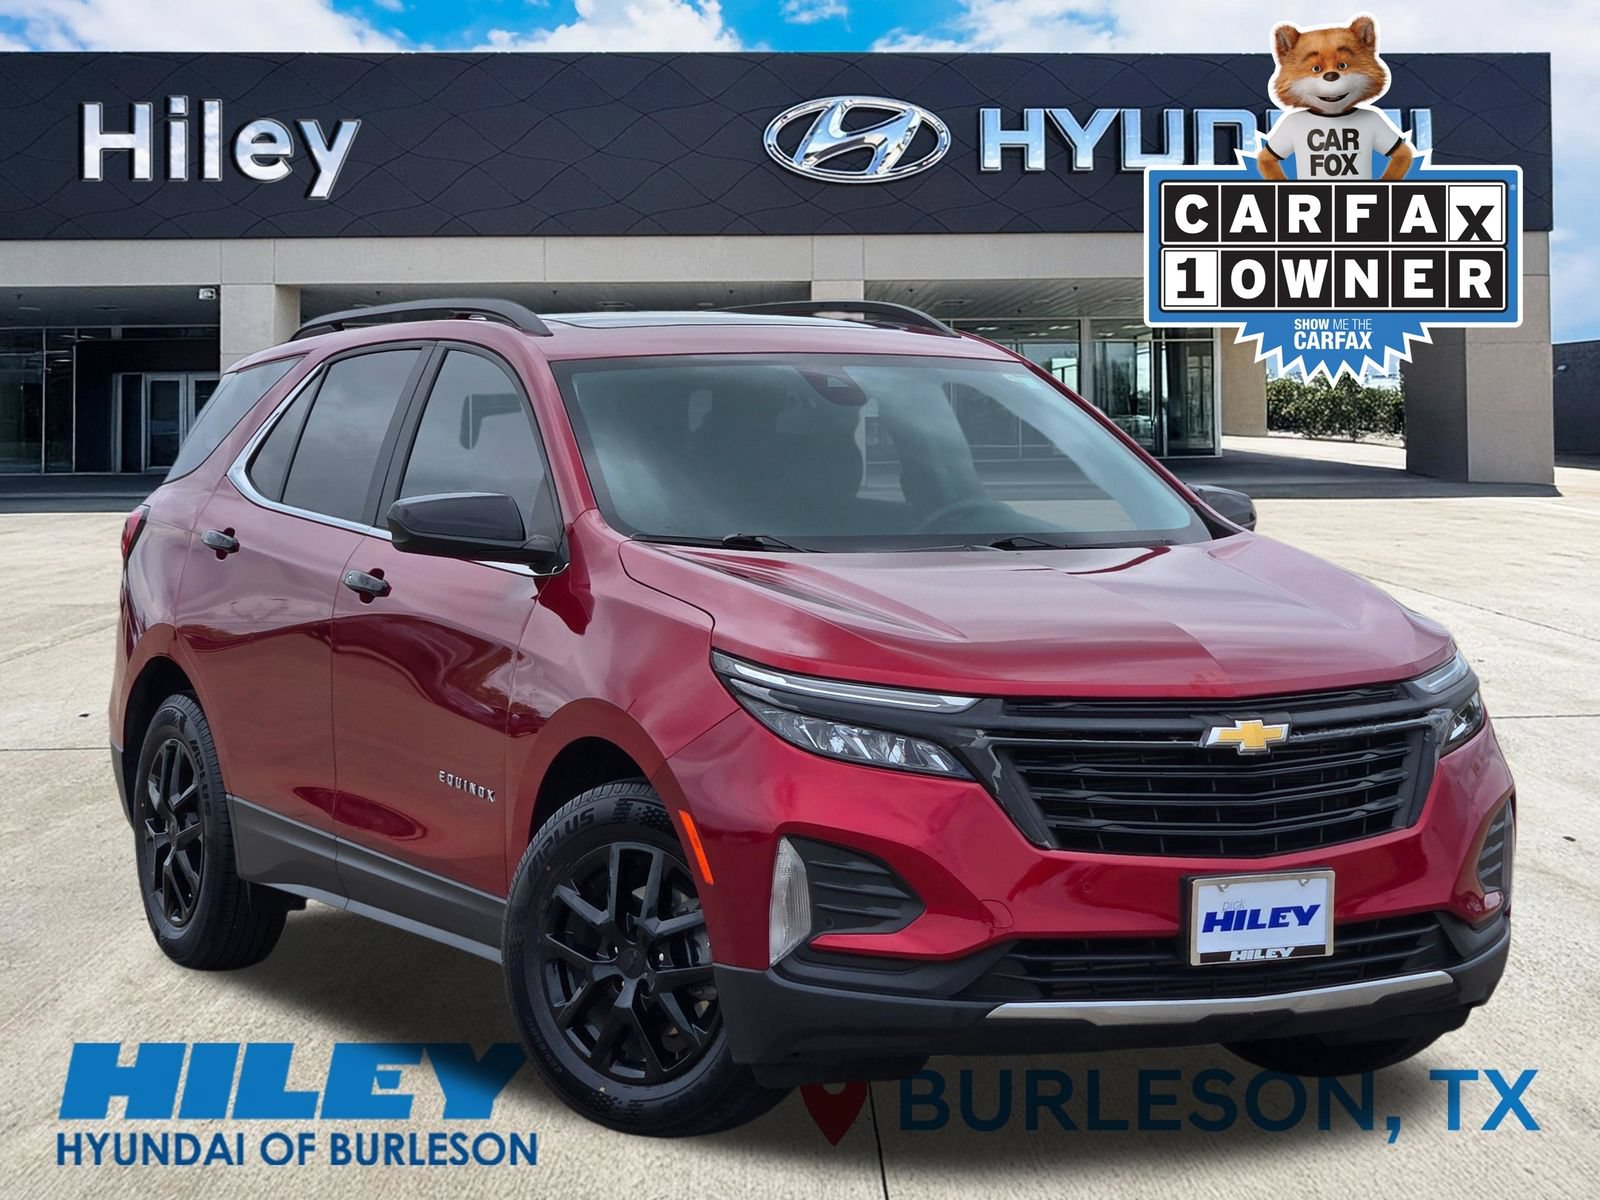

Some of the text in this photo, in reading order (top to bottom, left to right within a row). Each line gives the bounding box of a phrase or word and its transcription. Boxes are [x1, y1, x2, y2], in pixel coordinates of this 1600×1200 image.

[79, 96, 361, 199] Hiley
[980, 108, 1432, 170] HYUNI
[438, 770, 496, 803] EQUINOX
[1202, 903, 1321, 934] HILEY
[1229, 946, 1296, 962] HILEY
